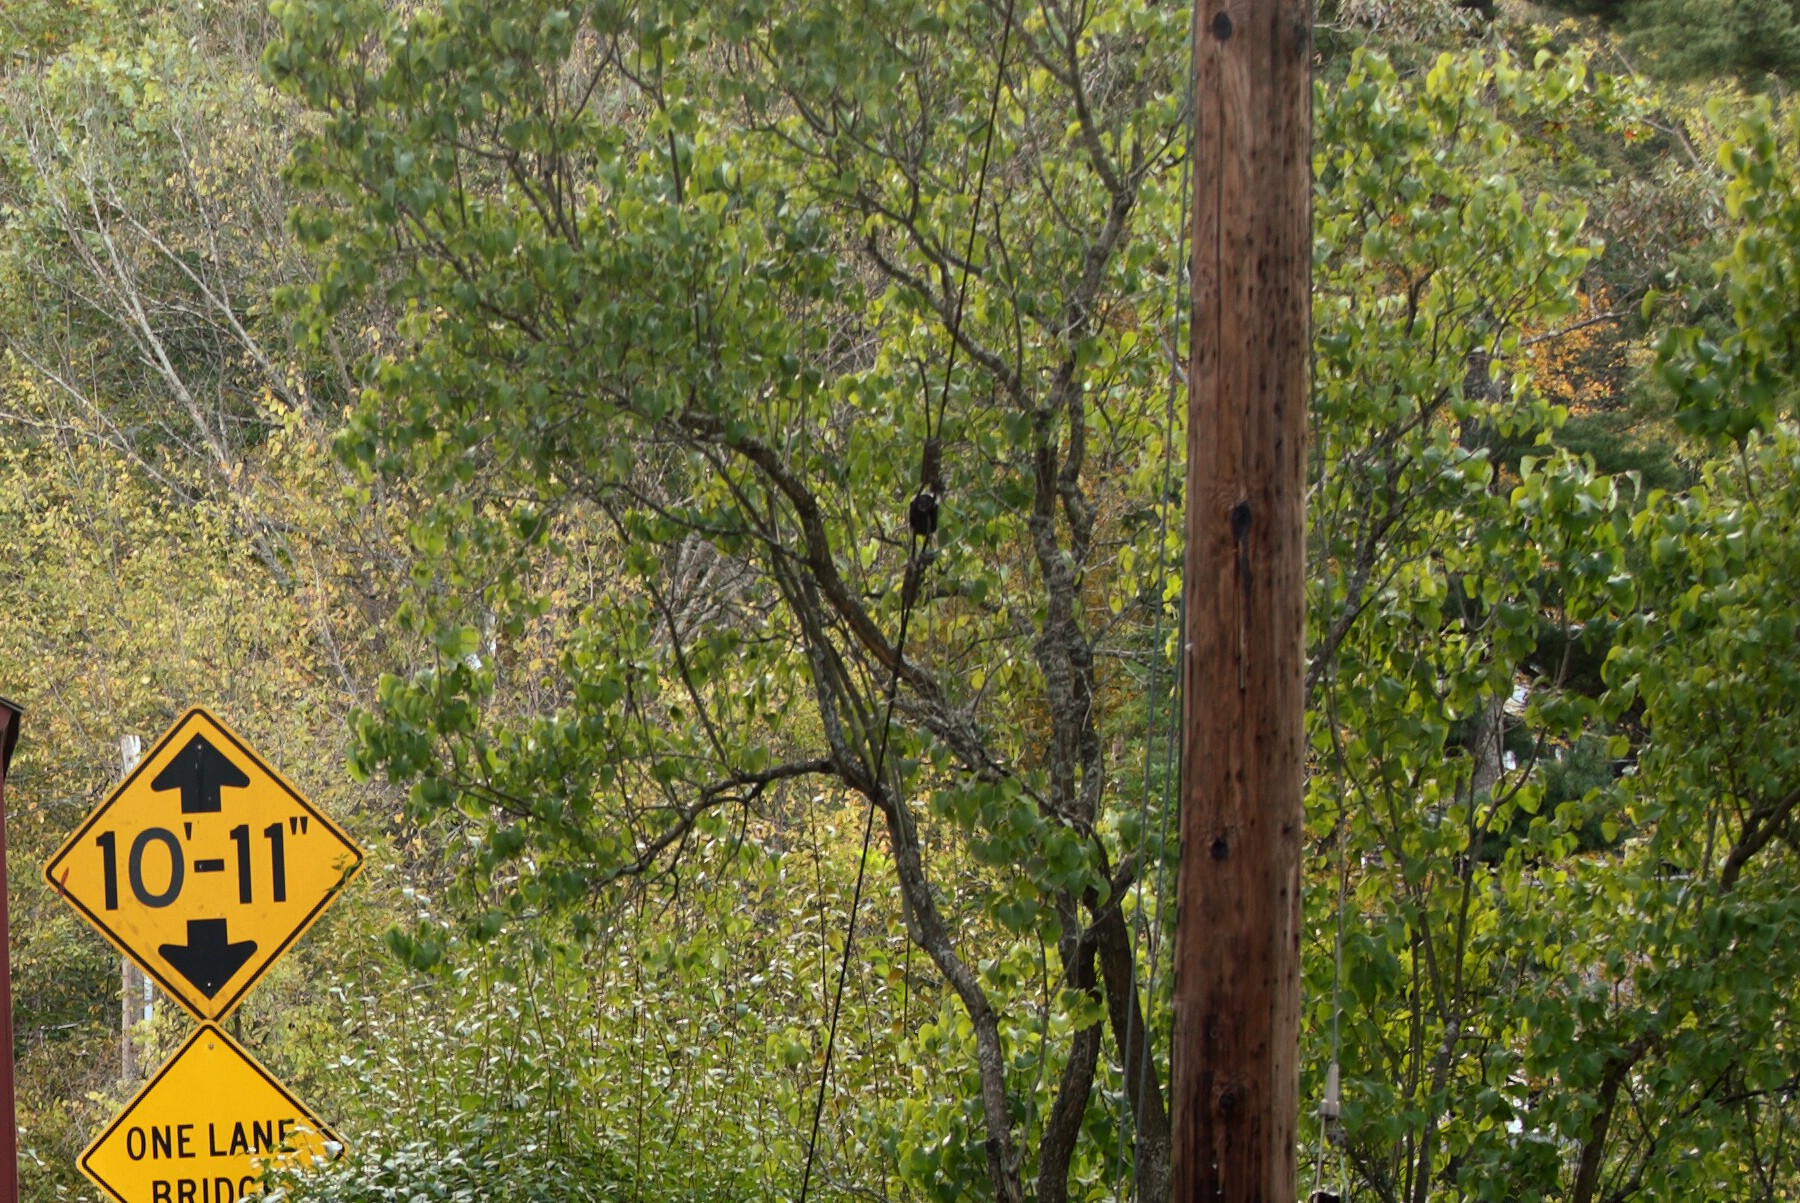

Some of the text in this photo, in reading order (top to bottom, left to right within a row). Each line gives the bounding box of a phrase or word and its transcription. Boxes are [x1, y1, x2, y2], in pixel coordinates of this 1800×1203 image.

[96, 816, 308, 911] 10'-11"
[126, 1119, 296, 1161] ONE LANE
